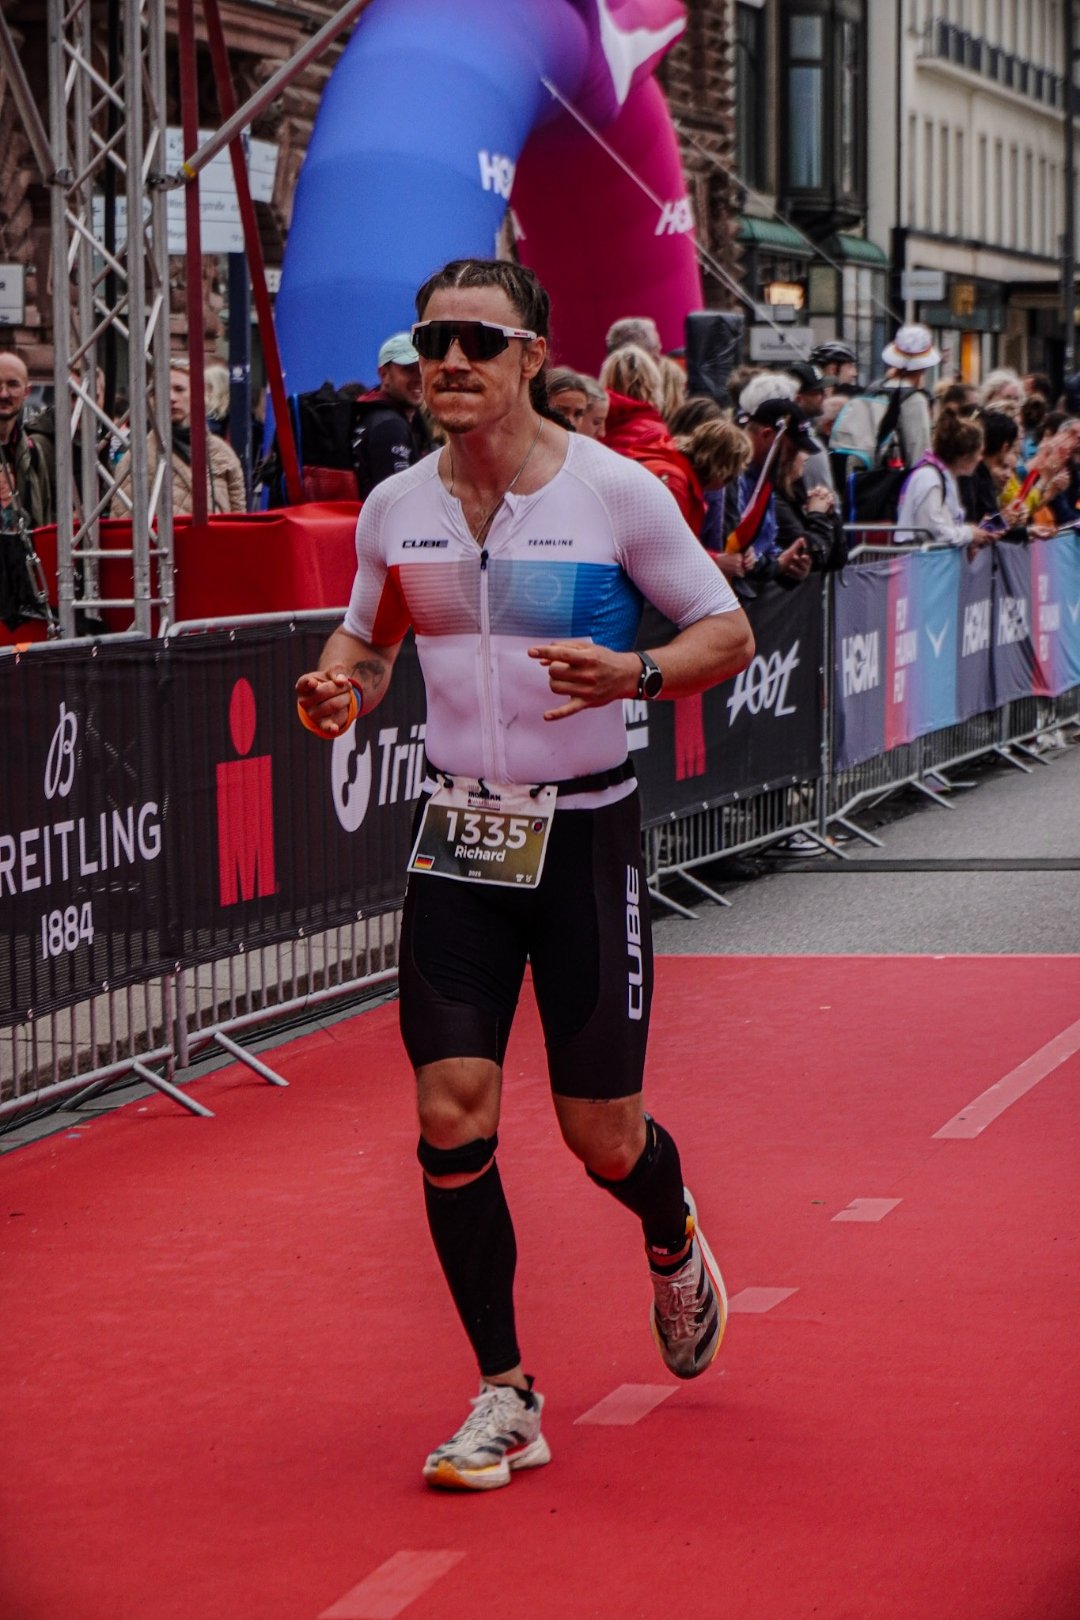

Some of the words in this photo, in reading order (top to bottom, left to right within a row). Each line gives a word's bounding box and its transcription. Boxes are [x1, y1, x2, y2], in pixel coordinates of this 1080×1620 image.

[402, 539, 449, 549] CUBE
[528, 539, 574, 547] TEAMLINE
[841, 631, 880, 699] HOKA
[446, 810, 530, 849] 1335
[454, 845, 507, 862] Richard
[41, 901, 94, 960] 1884
[626, 864, 643, 1020] CUBE
